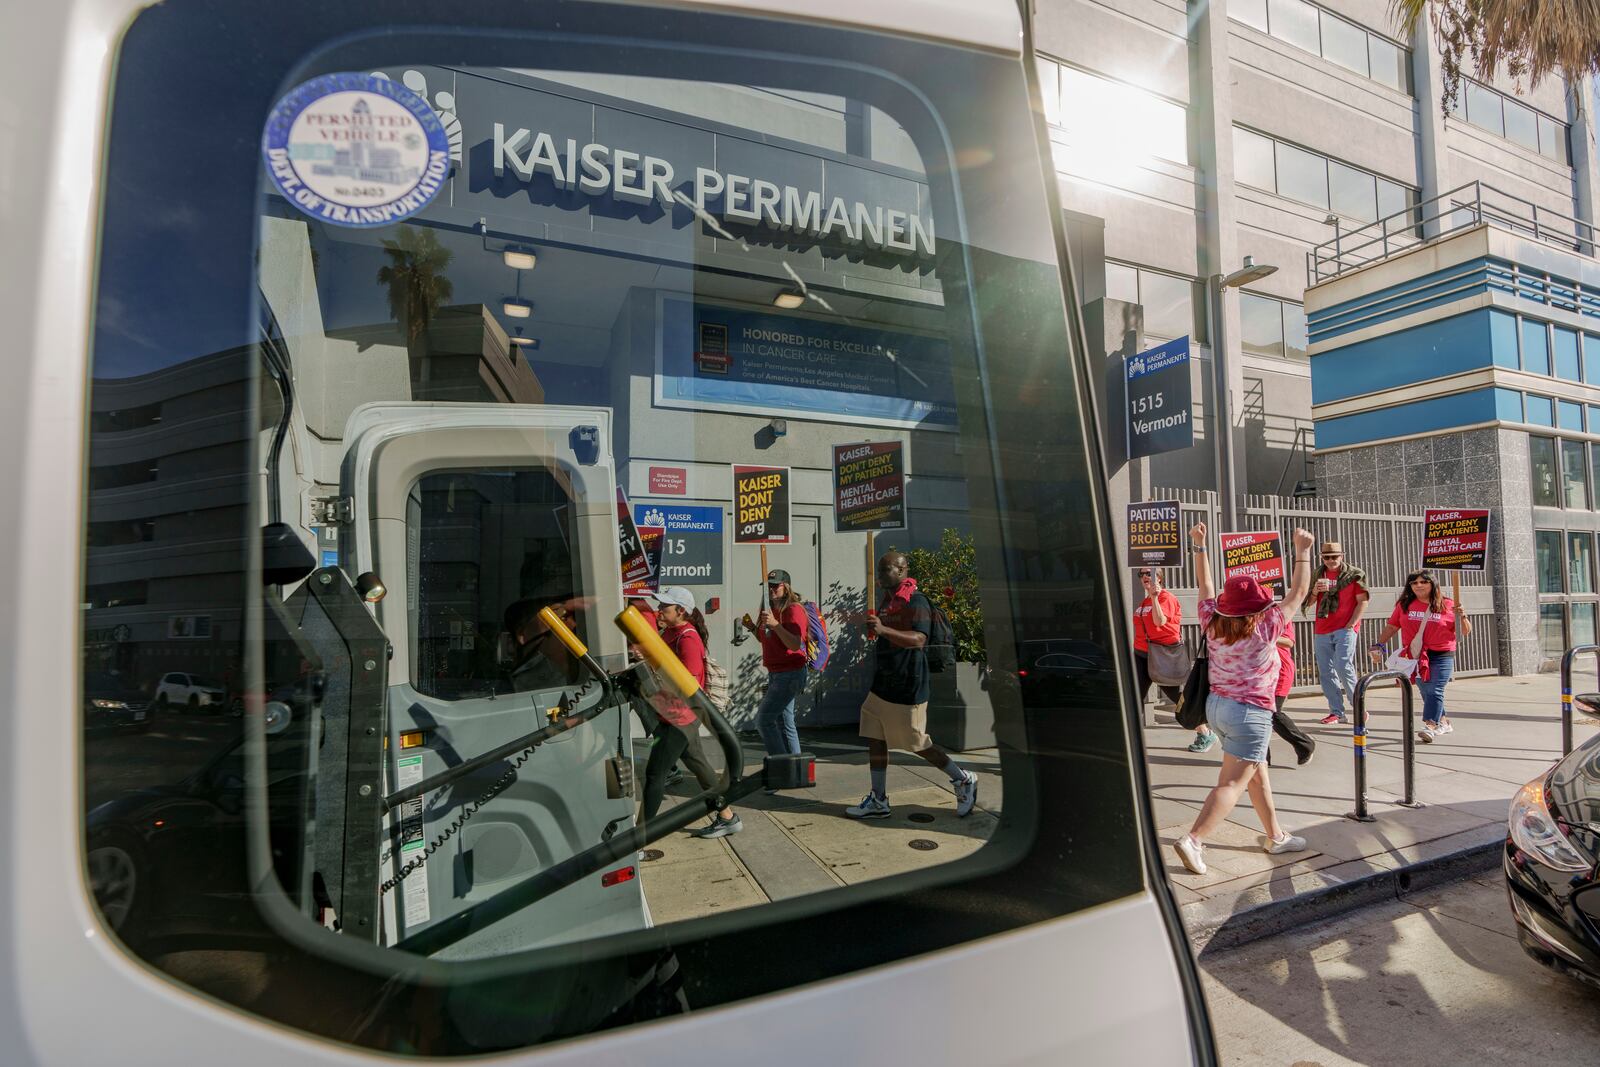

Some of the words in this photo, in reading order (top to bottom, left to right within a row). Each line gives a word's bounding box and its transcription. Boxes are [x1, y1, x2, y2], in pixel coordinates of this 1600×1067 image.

[306, 113, 412, 126] PERMITTED
[320, 129, 400, 142] VEHICLE
[493, 122, 675, 208] KAISER
[267, 148, 296, 194] DEPT.
[295, 187, 323, 211] OF
[321, 150, 448, 224] TRANSPORTATION
[743, 327, 805, 345] HONORED
[807, 336, 830, 349] FOR
[743, 343, 755, 354] IN
[758, 345, 805, 361] CANCER
[807, 351, 836, 364] CARE
[1146, 351, 1167, 363] KAISER
[1146, 352, 1187, 373] PERMANENTE
[817, 368, 844, 379] Angeles
[1131, 392, 1164, 415] 1515
[1132, 409, 1188, 436] Vermont
[839, 446, 873, 462] KAISER,
[840, 459, 869, 475] DON'T
[868, 453, 892, 468] DENY
[840, 473, 854, 486] MY
[855, 464, 894, 482] PATIENTS
[739, 474, 782, 493] KAISER
[840, 482, 876, 499] MENTAL
[739, 490, 774, 508] DONT
[841, 493, 874, 510] HEALTH
[875, 486, 900, 501] CARE
[668, 513, 692, 521] KAISER
[740, 505, 772, 524] DENY
[1130, 507, 1177, 521] PATIENTS
[1429, 511, 1463, 522] KAISER,
[667, 520, 714, 530] PERMANENTE
[741, 522, 765, 535] .org
[1130, 521, 1177, 533] BEFORE
[1428, 530, 1441, 538] MY
[1442, 525, 1479, 536] PATIENTS
[1429, 521, 1455, 531] DON'T
[1455, 518, 1479, 528] DENY
[1130, 533, 1178, 545] PROFITS
[1225, 535, 1256, 548] KAISER,
[1427, 537, 1461, 547] MENTAL
[663, 538, 686, 555] 15
[1227, 546, 1250, 559] DON'T
[1251, 541, 1271, 553] DENY
[1427, 545, 1459, 554] HEALTH
[1459, 541, 1483, 550] CARE
[1228, 557, 1240, 567] MY
[1240, 550, 1274, 564] PATIENTS
[660, 563, 712, 577] ermont
[1229, 564, 1260, 578] MENTAL
[1260, 567, 1280, 579] CARE
